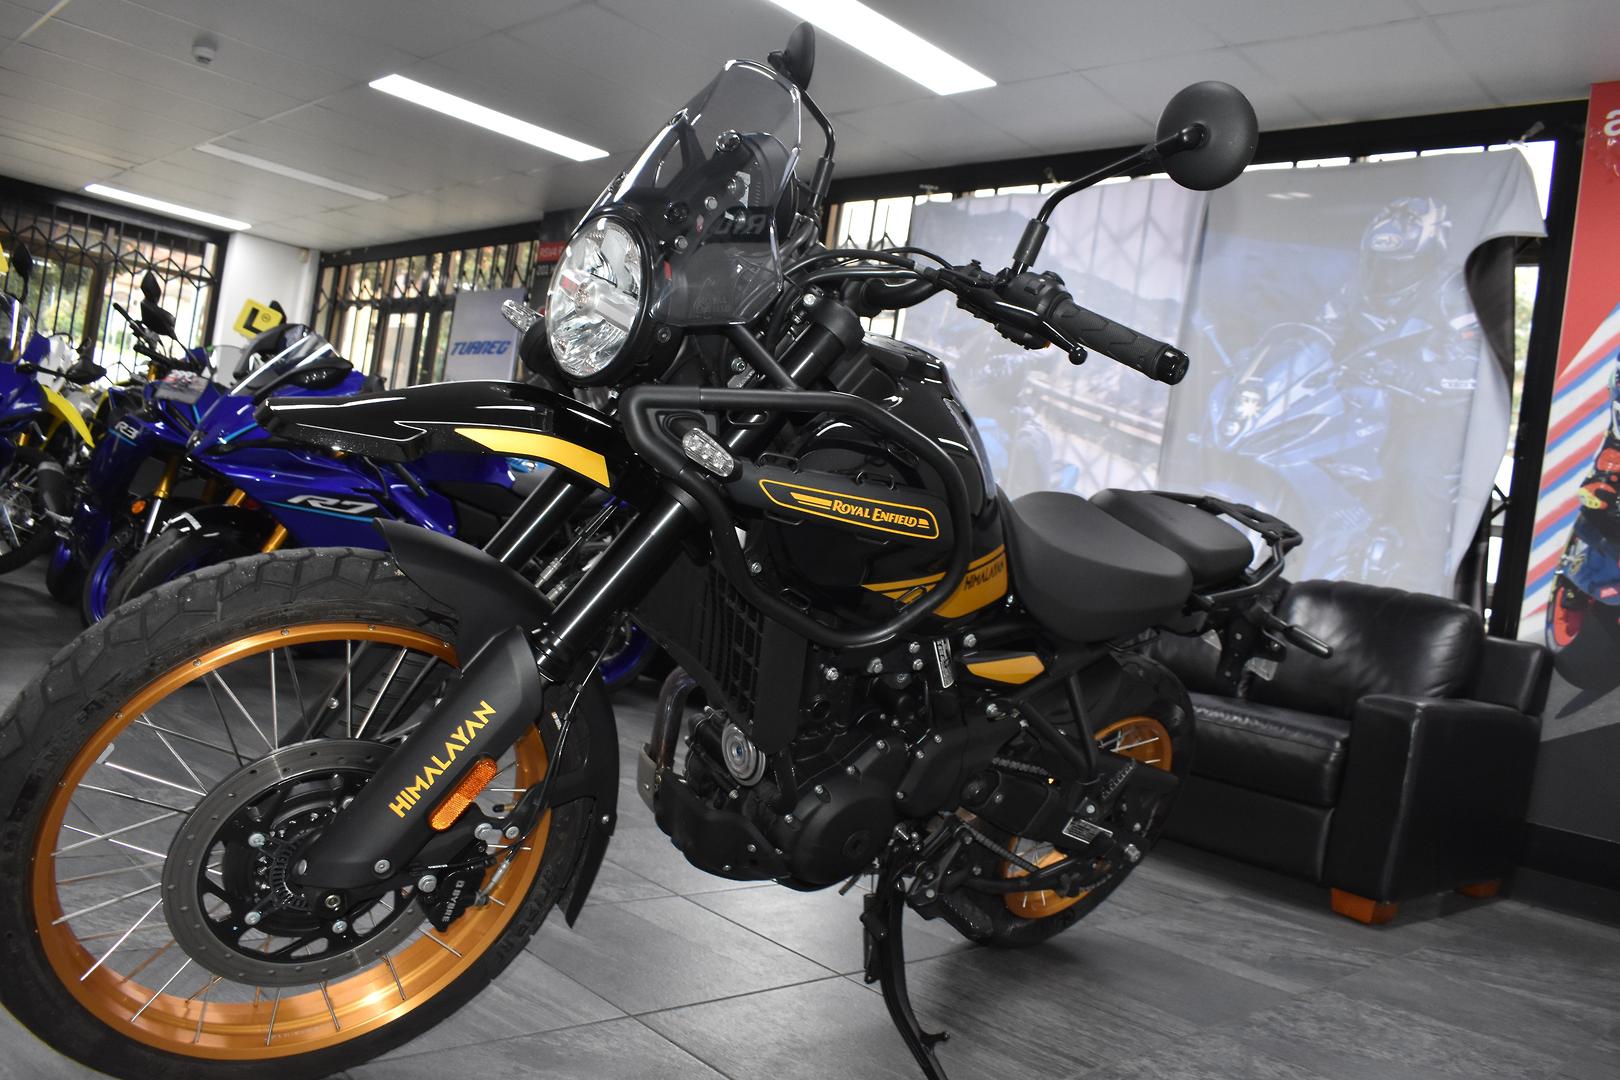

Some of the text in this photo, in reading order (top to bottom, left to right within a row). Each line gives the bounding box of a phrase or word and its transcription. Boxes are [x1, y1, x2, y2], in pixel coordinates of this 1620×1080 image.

[243, 307, 264, 335] L
[114, 420, 139, 440] R3
[287, 494, 379, 514] R7
[832, 499, 918, 527] ROYAL ENFIELD
[388, 700, 497, 818] HIMALAYAN
